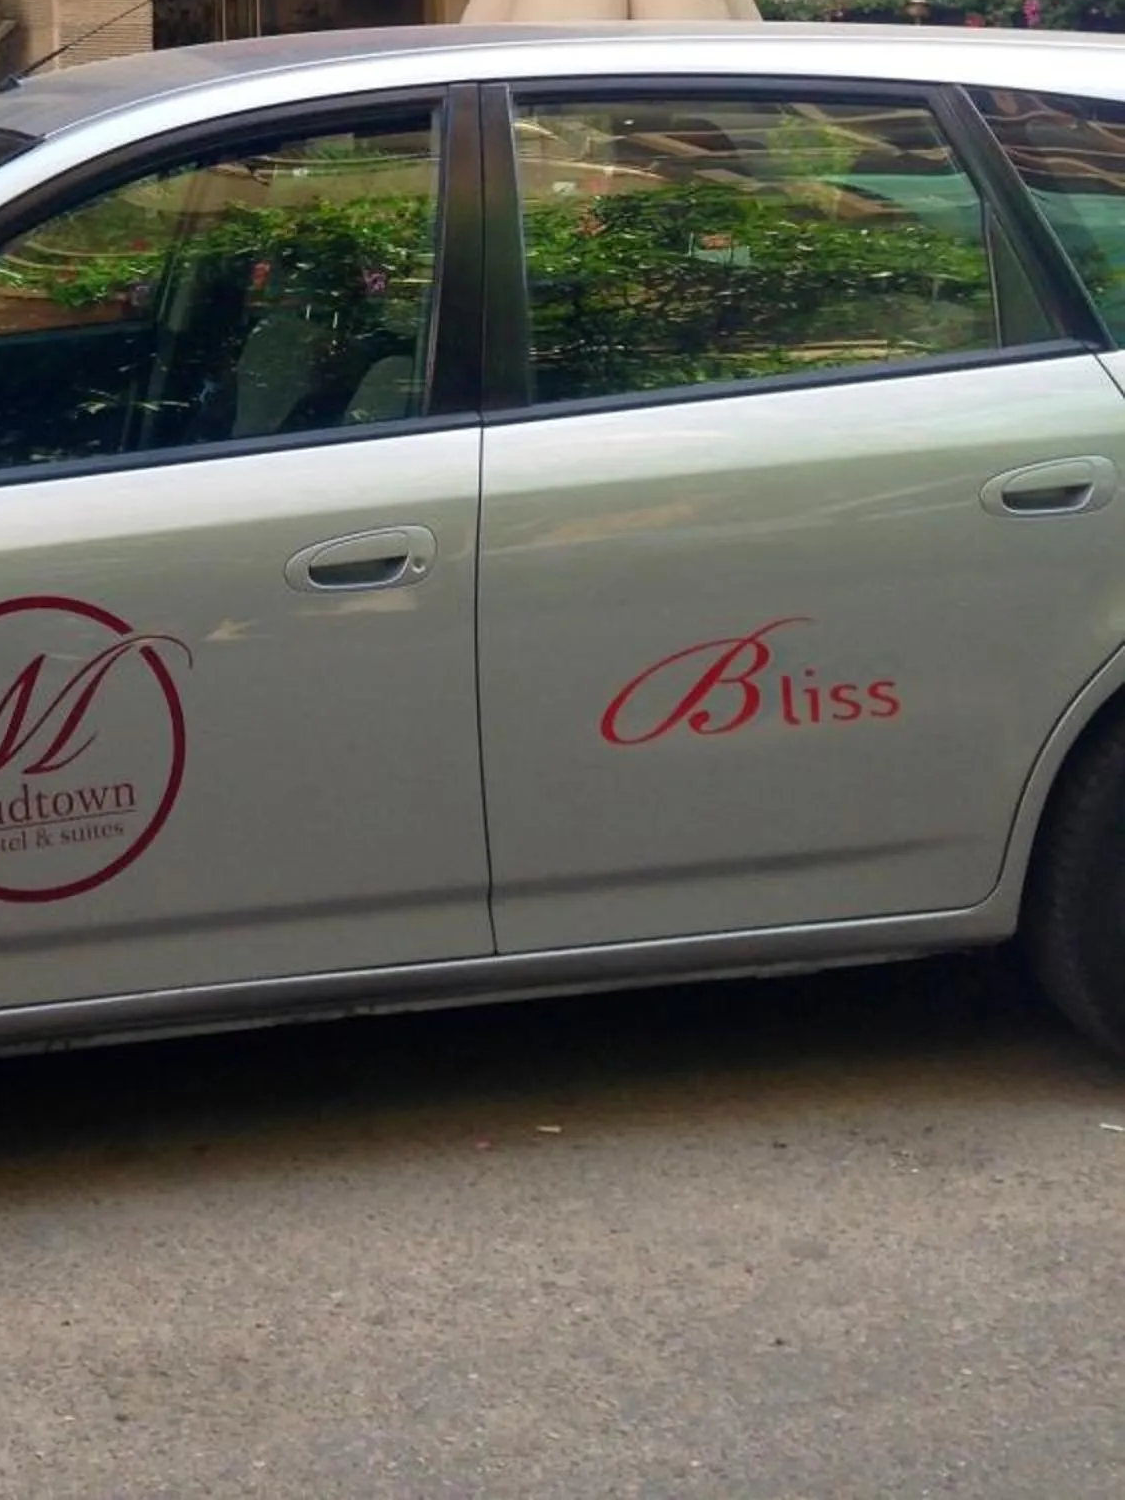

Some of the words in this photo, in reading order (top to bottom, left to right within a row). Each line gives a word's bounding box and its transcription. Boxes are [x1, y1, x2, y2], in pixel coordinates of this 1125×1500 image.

[599, 616, 902, 745] Bliss
[35, 827, 53, 849] &
[59, 819, 125, 845] suites
